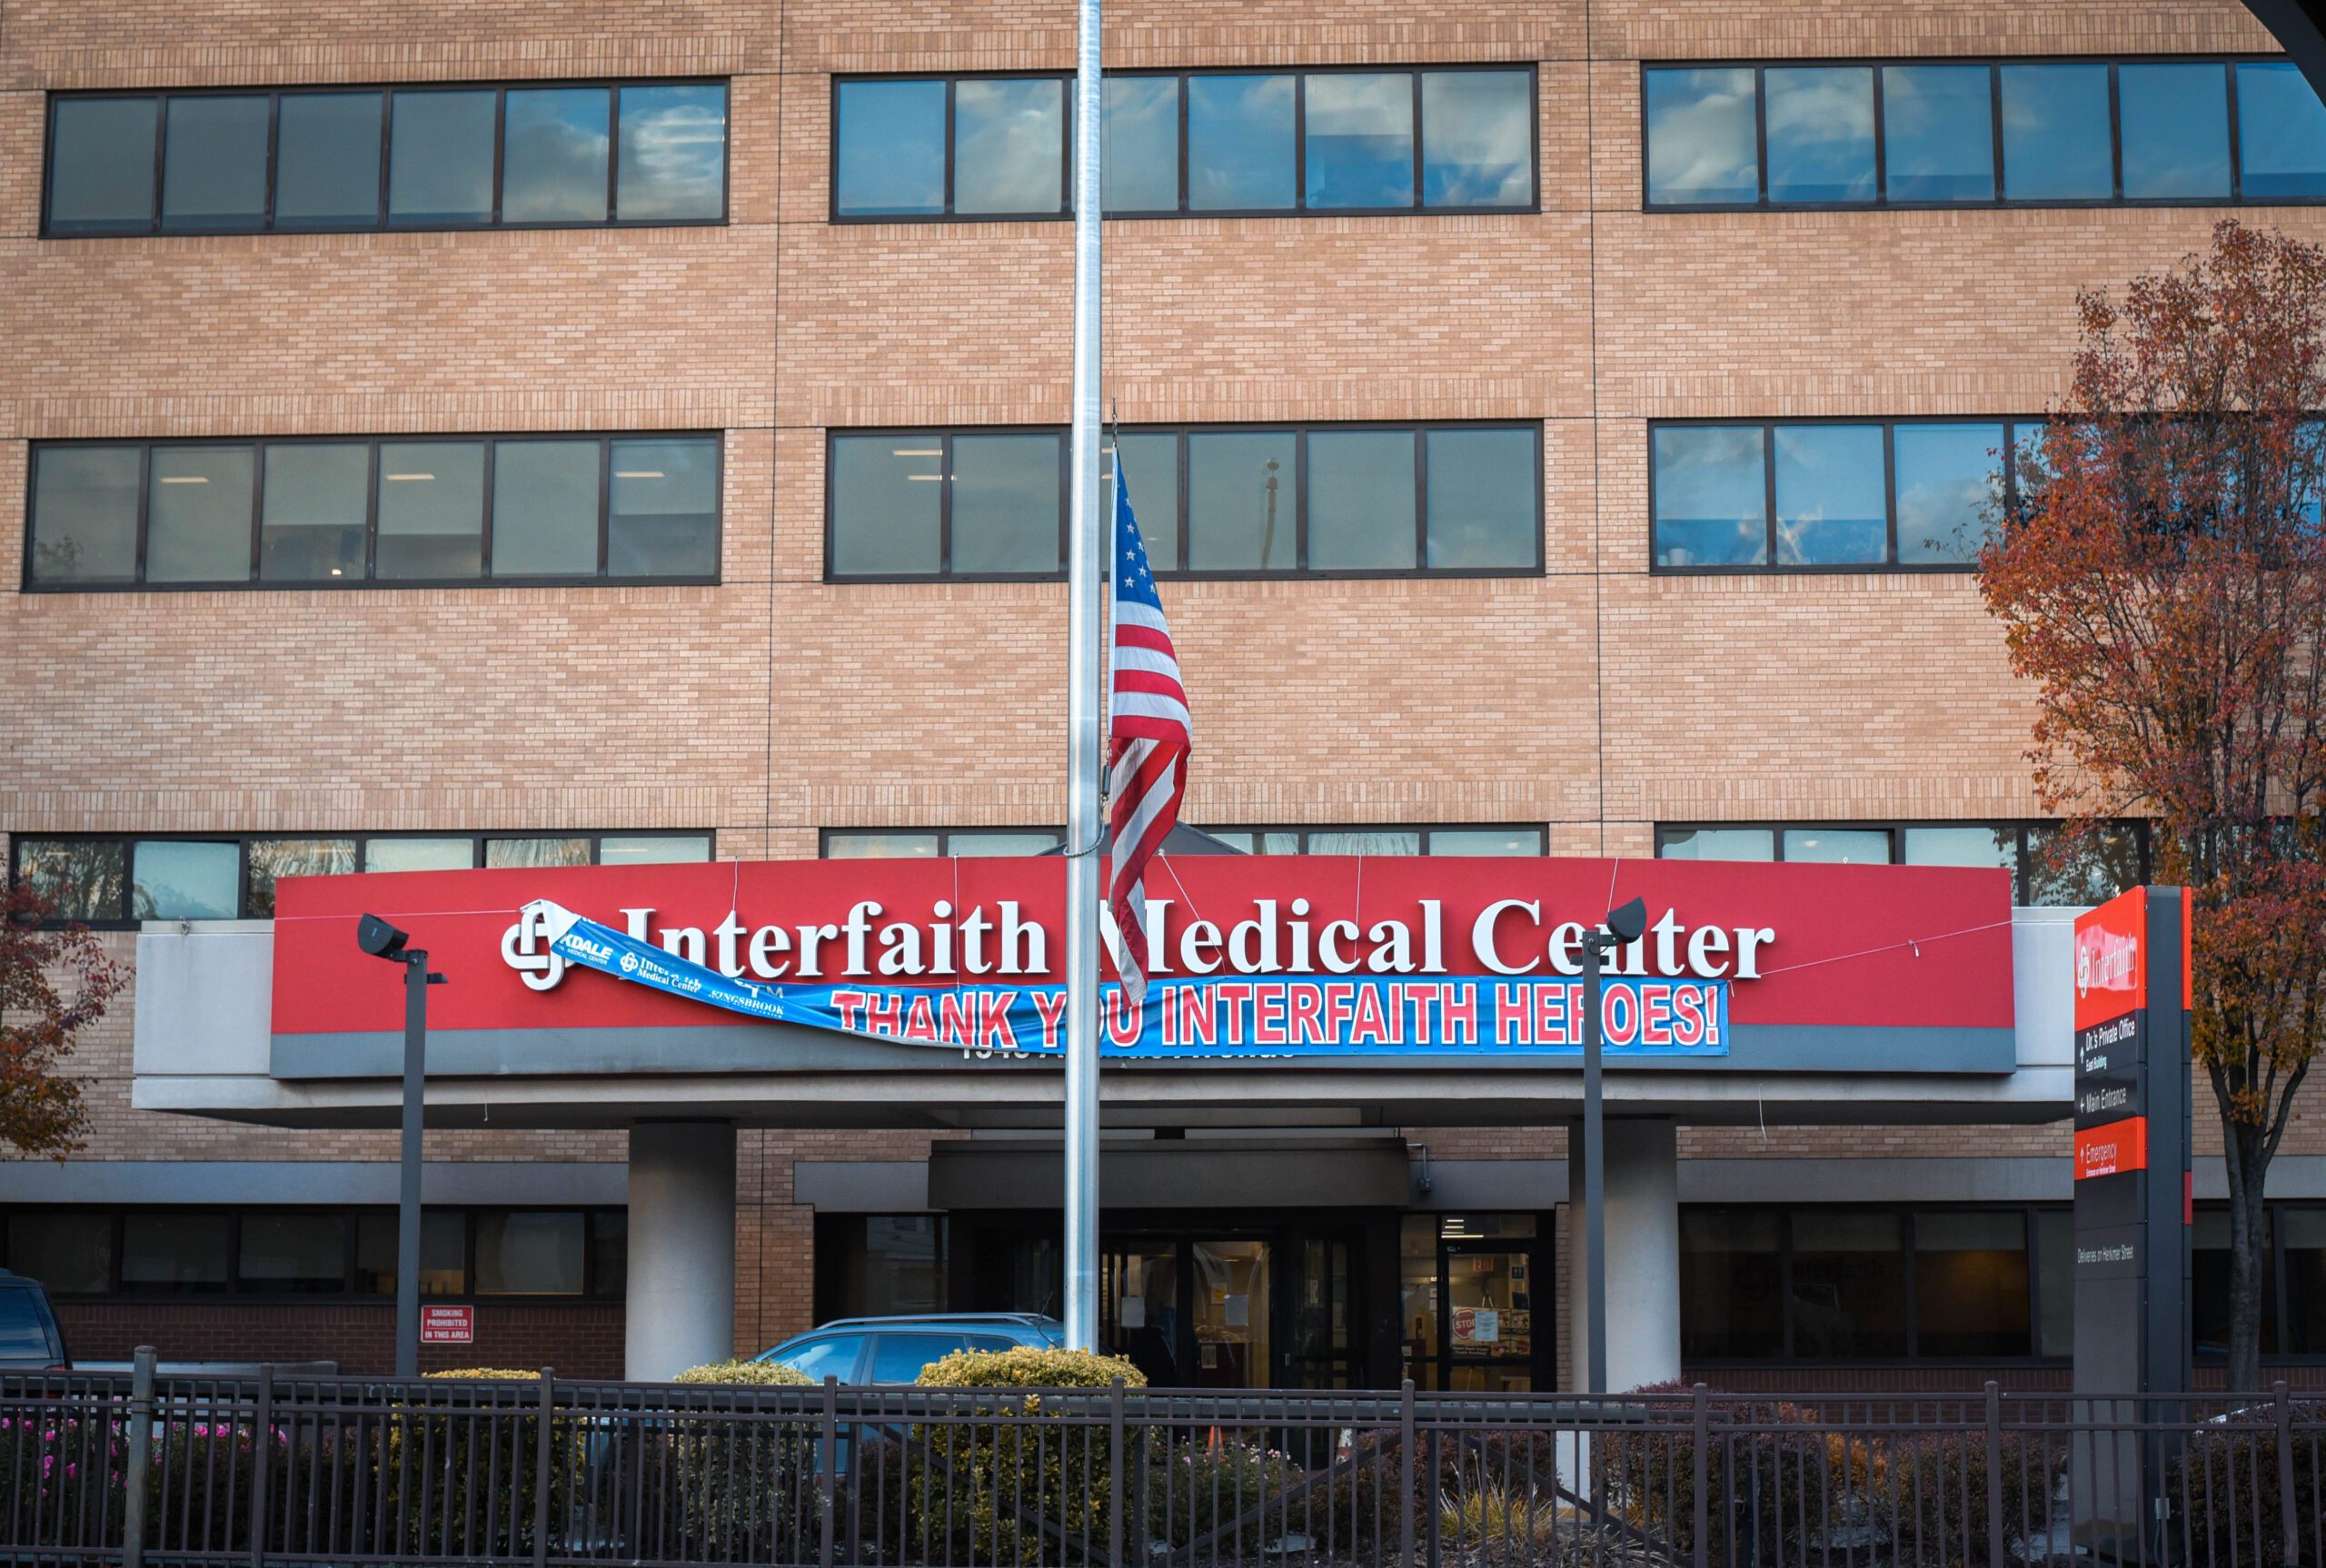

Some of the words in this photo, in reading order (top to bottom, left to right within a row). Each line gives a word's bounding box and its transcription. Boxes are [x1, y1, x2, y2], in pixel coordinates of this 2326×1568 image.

[1472, 898, 1775, 978] Center
[2092, 932, 2134, 987] Interfaith
[637, 968, 670, 986] Medical
[671, 978, 699, 993] Center
[830, 990, 1018, 1048] THANK
[1030, 991, 1144, 1047] YU
[1161, 982, 1477, 1046] INTERFAITH
[2099, 1025, 2118, 1047] Private
[2119, 1017, 2135, 1040] Office
[2086, 1092, 2100, 1114] Main
[2101, 1087, 2127, 1109] Entrance
[2086, 1142, 2117, 1166] Emergency
[2078, 1247, 2096, 1264] Deliveries
[2097, 1250, 2102, 1262] on
[2102, 1245, 2120, 1262] Herkimer
[2122, 1244, 2133, 1260] Street
[432, 1309, 463, 1317] SMOKING
[451, 1331, 469, 1339] AREA
